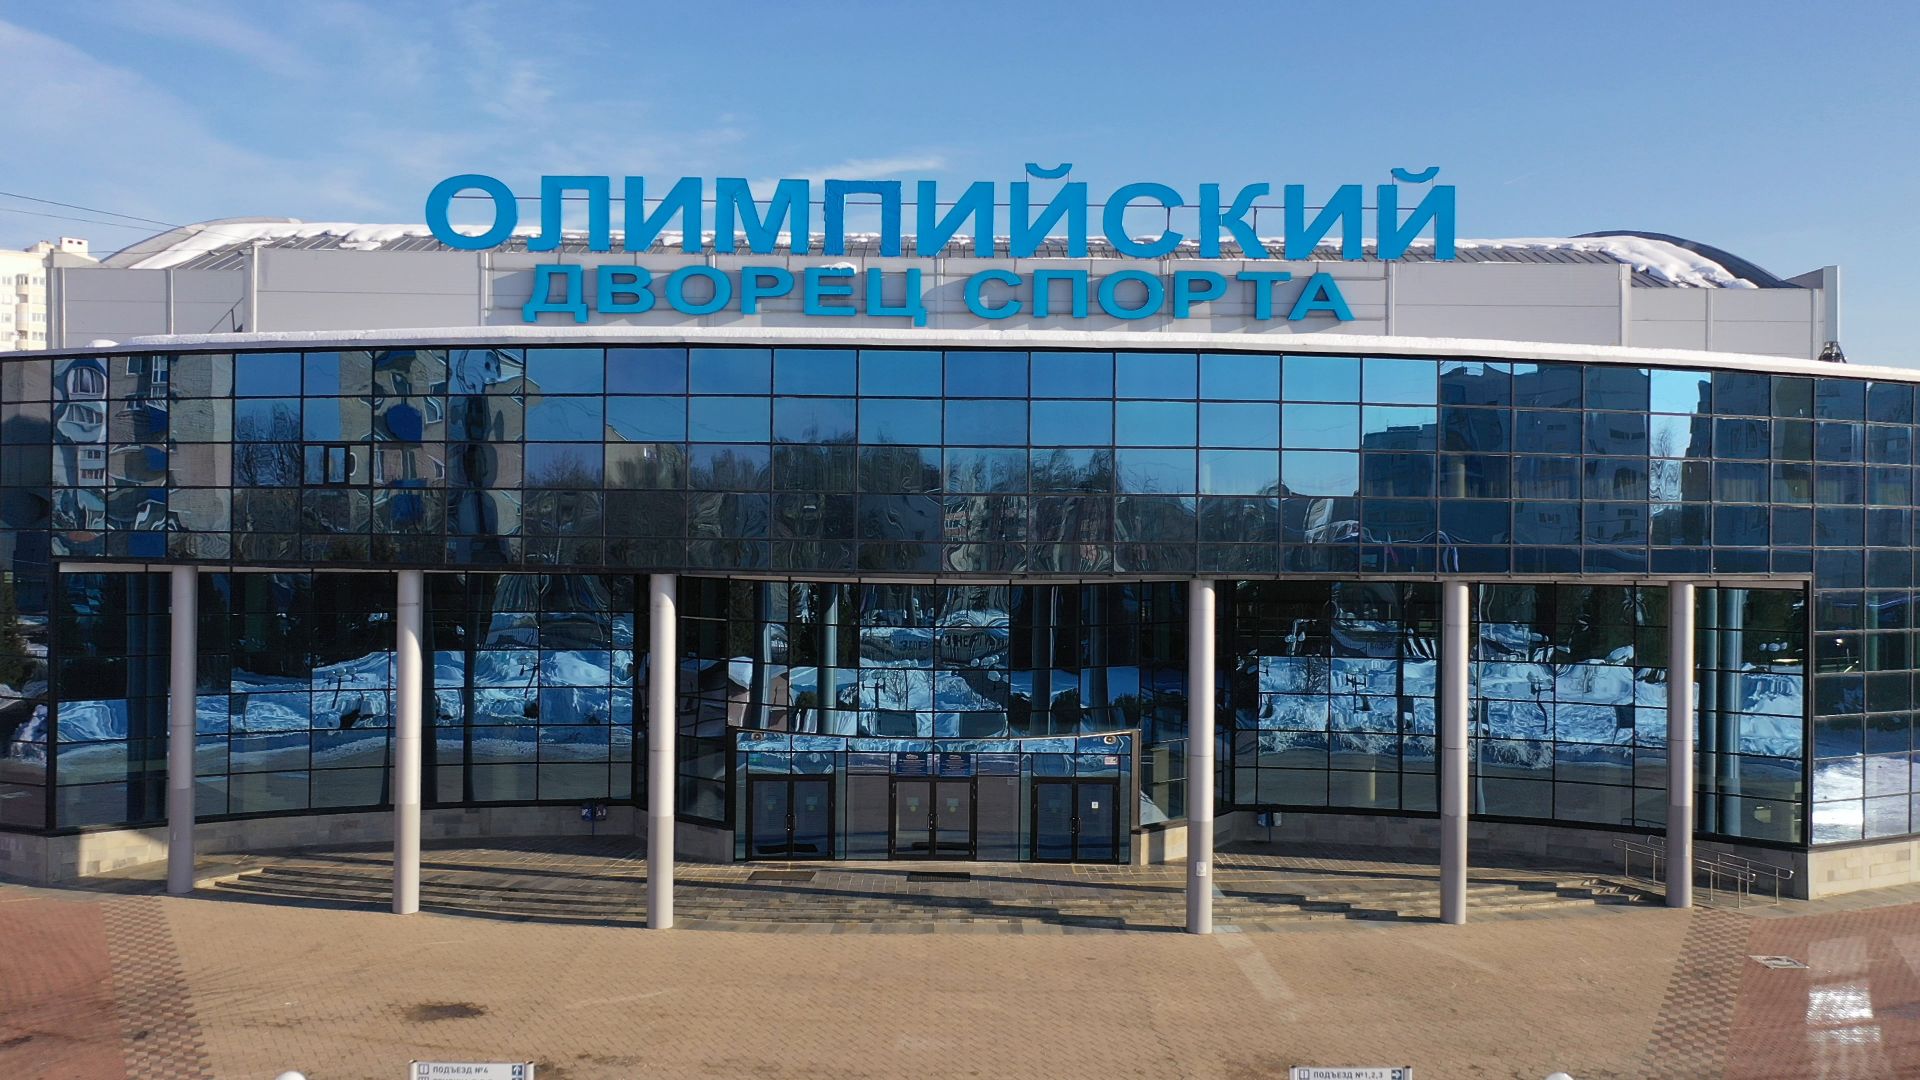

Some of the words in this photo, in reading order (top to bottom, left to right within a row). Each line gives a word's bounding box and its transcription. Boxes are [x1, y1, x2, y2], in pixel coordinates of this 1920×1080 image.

[426, 163, 1456, 262] ОЛИМПИЙСКИЙ
[521, 264, 928, 326] ДВОРЕЦ
[963, 269, 1354, 322] СПОРТА
[433, 1066, 472, 1074] ПОДЪЕЗД
[1314, 1072, 1352, 1080] ПОДЪЕЗД
